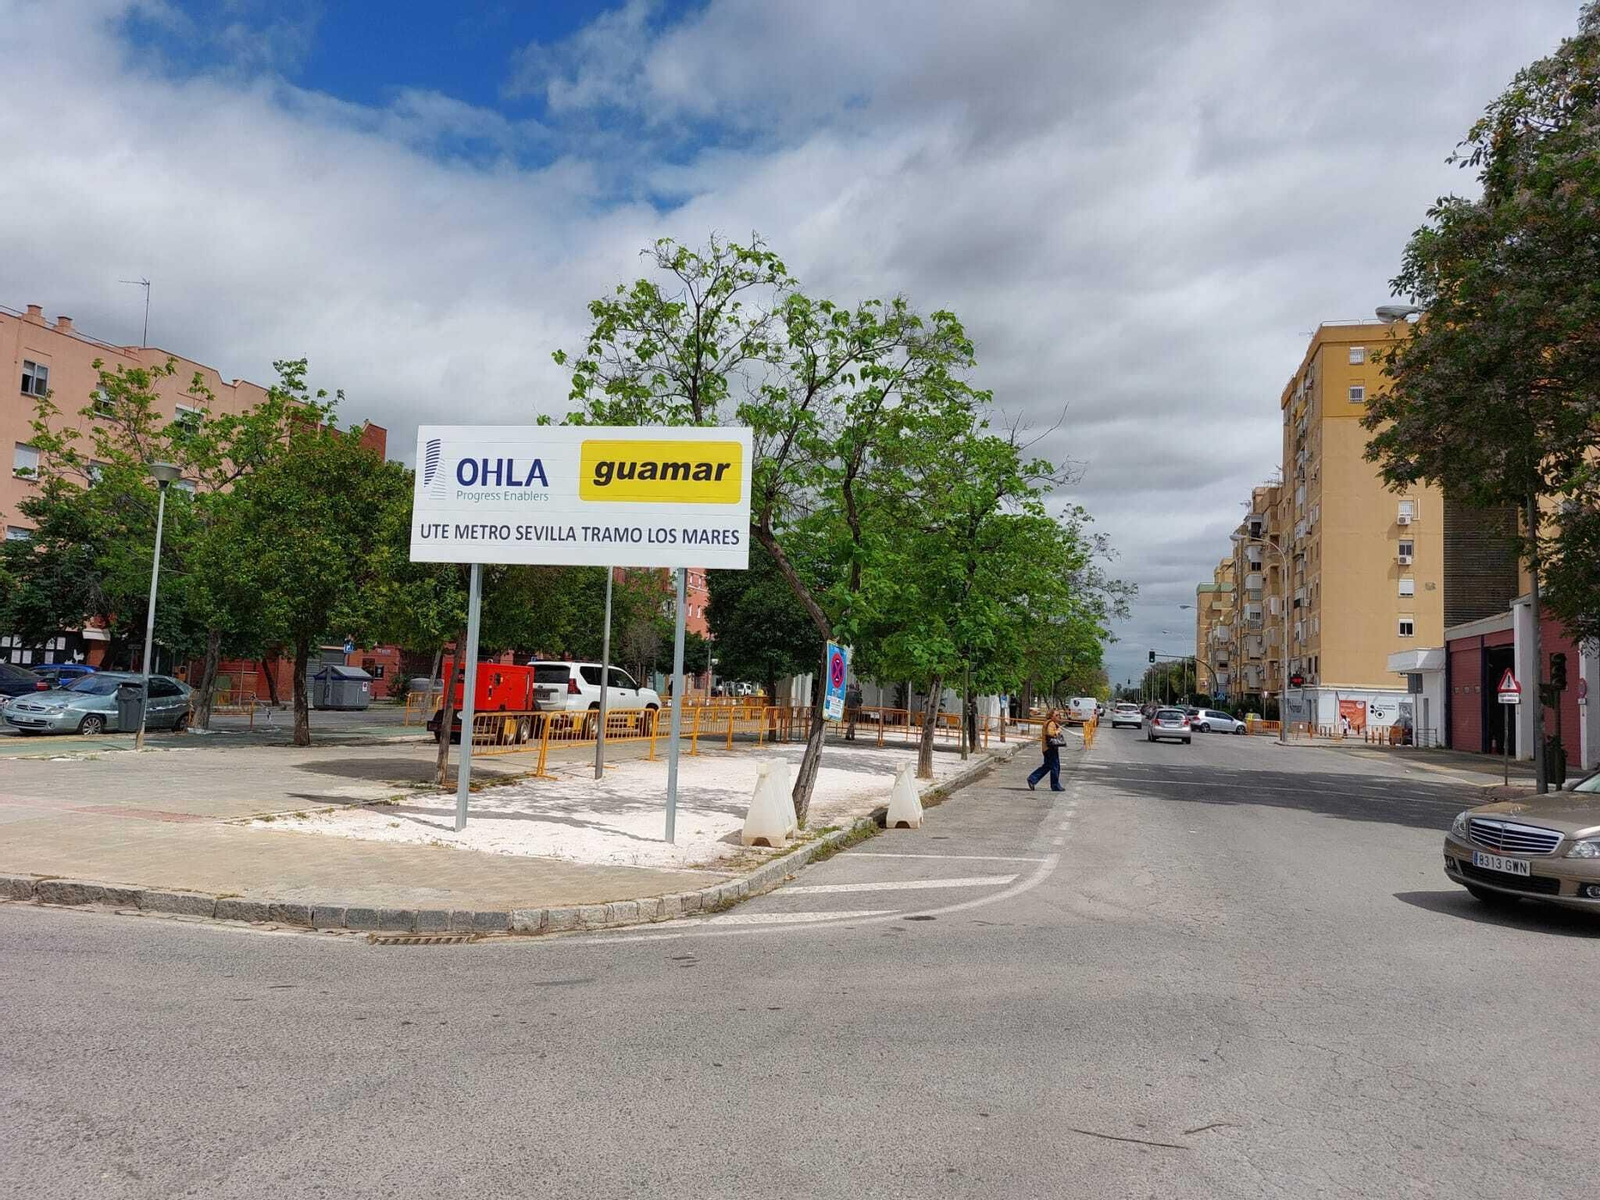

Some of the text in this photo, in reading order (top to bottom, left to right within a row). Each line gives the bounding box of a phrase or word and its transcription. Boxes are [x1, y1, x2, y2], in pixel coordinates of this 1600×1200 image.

[456, 457, 549, 487] OHLA
[593, 461, 731, 486] guamar
[456, 490, 549, 503] Progress Enablers
[420, 523, 740, 545] UTE METRO SEVILLA TRAMO LOS MARES
[1479, 854, 1527, 875] 8313 GWN
